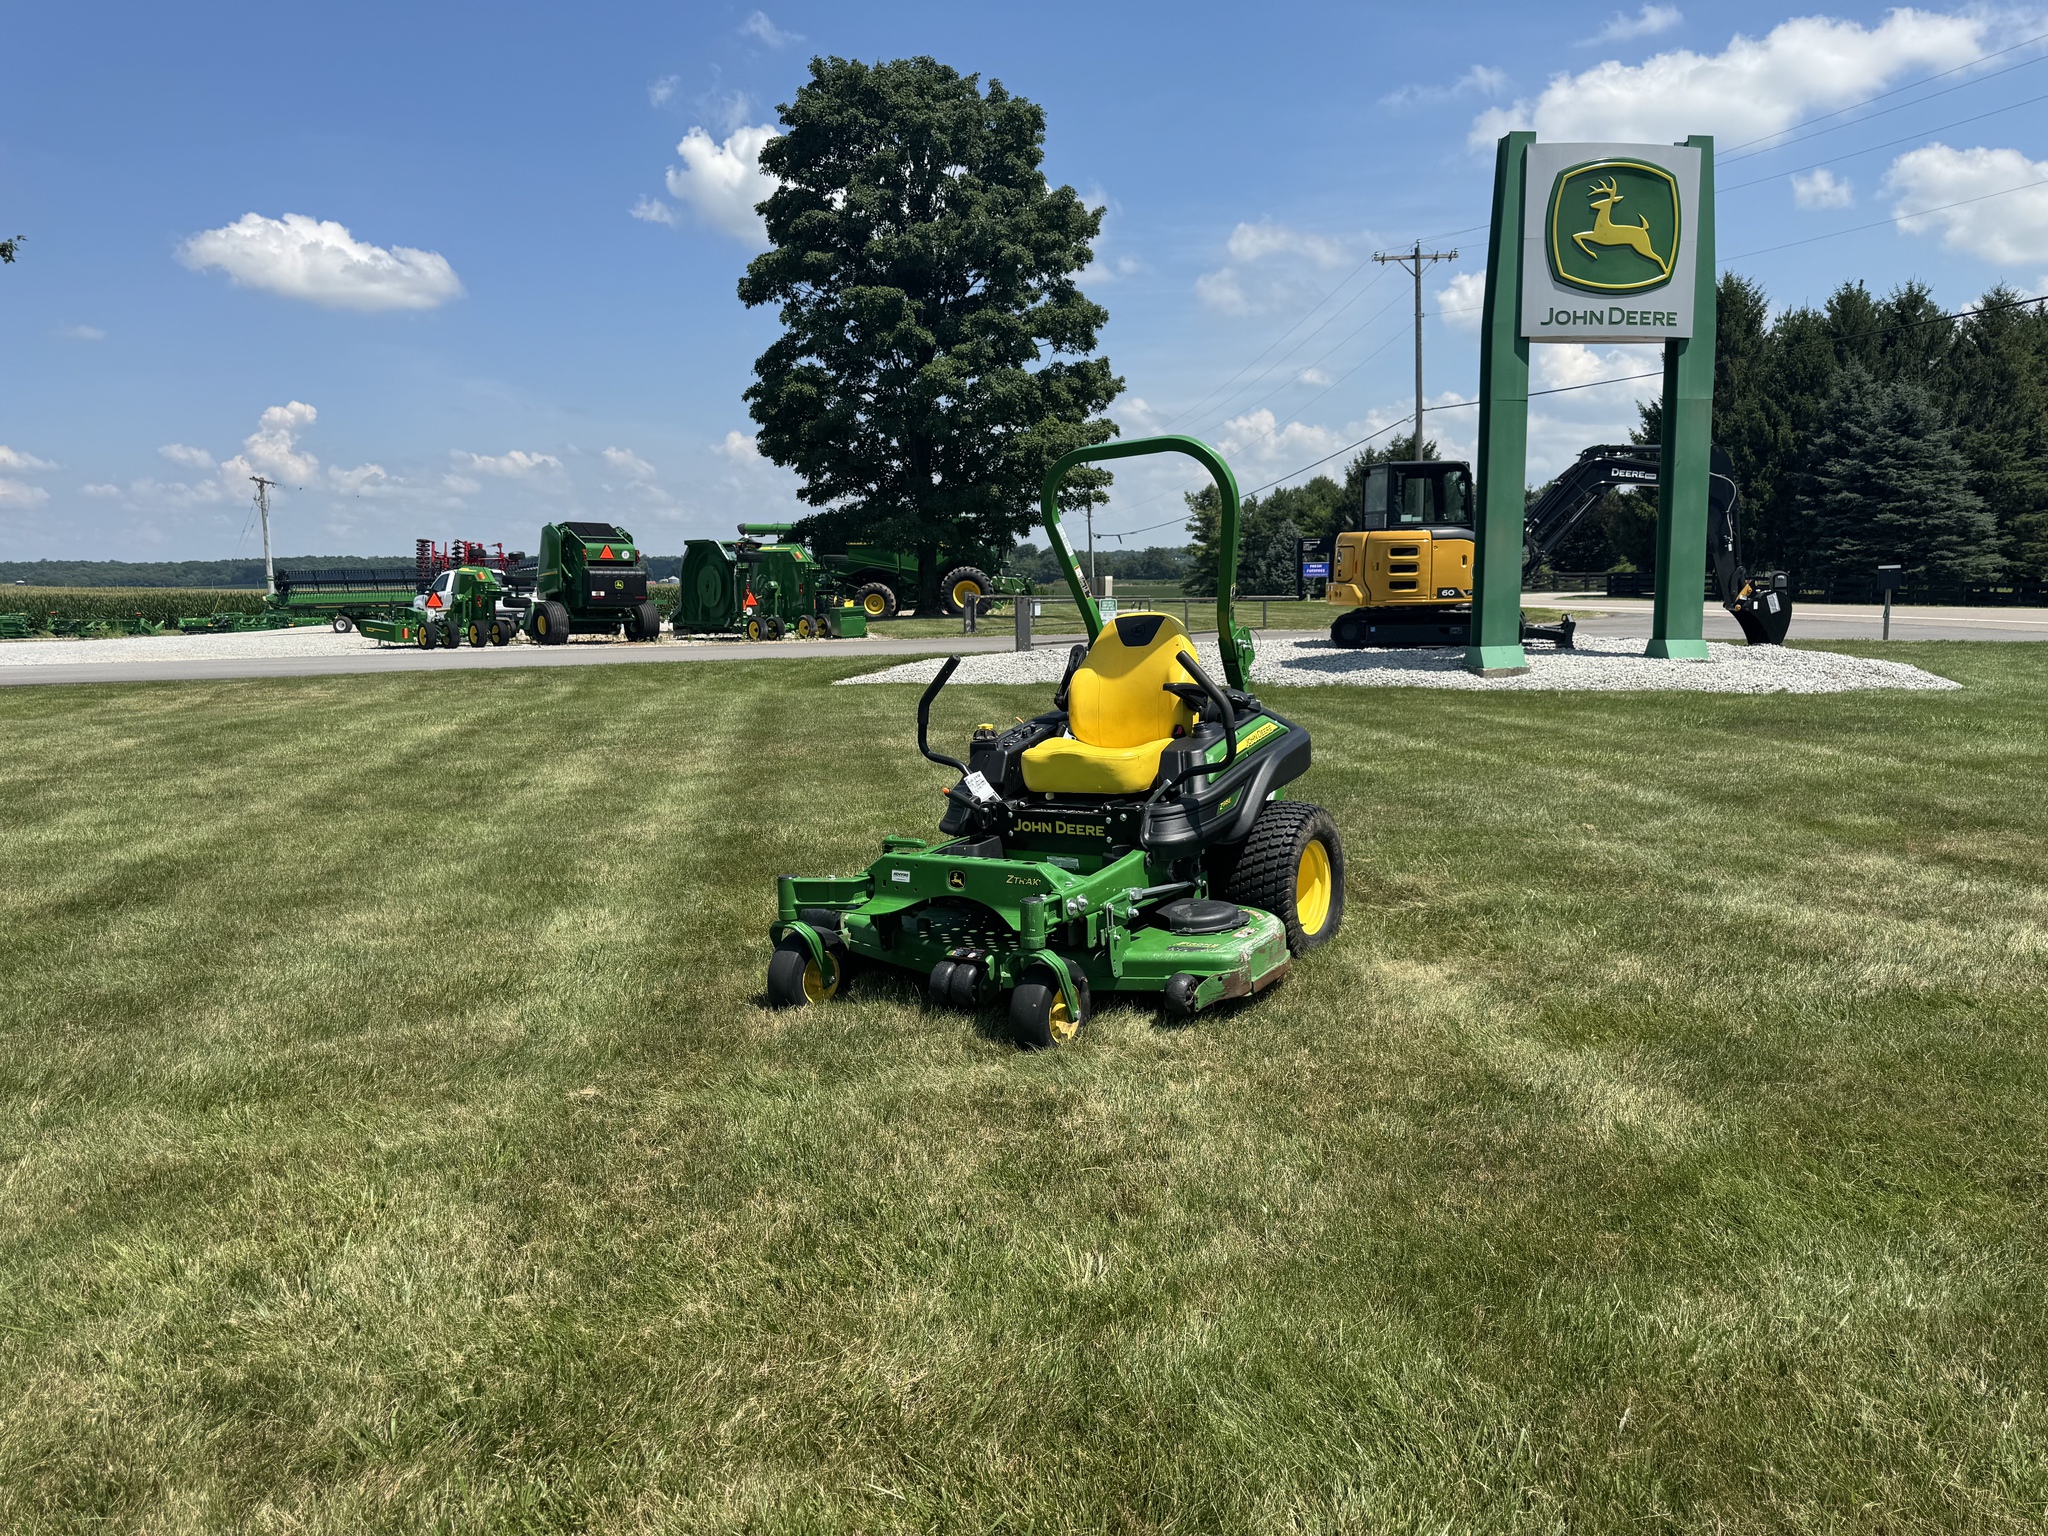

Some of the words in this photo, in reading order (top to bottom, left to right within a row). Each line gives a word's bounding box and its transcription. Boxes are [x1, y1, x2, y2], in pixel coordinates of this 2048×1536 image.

[1541, 307, 1604, 326] JOHN
[1608, 307, 1678, 327] DEERE
[1611, 467, 1646, 479] DEERE
[1246, 735, 1258, 747] JOHN
[1257, 725, 1272, 740] DEERE
[1013, 818, 1052, 834] JOHN
[1055, 820, 1105, 837] DEERE
